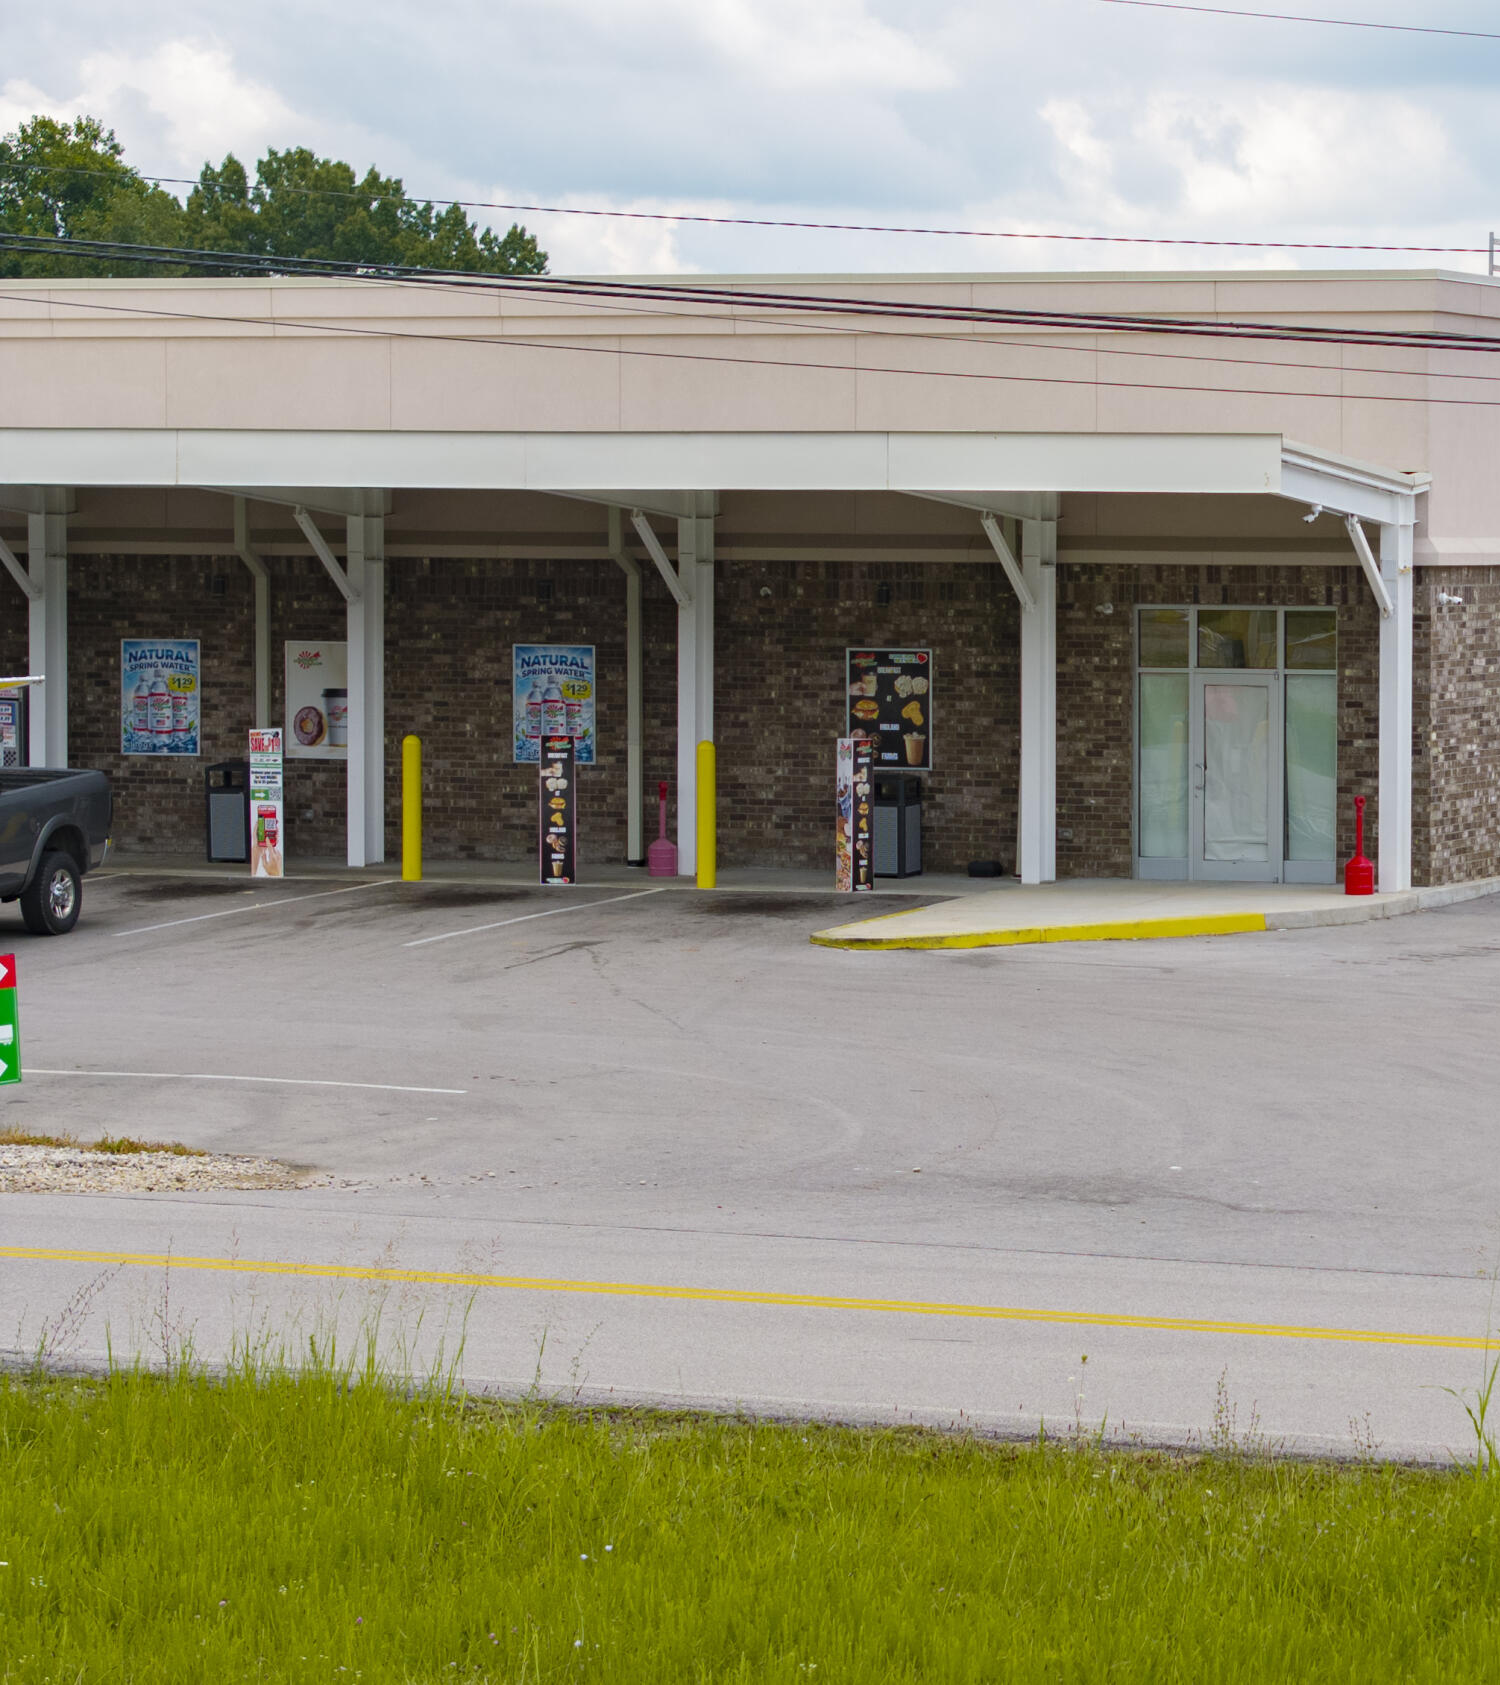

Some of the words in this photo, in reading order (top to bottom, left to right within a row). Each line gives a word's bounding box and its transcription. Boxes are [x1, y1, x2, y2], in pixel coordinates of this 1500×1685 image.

[128, 648, 193, 663] NATURAL
[521, 655, 589, 669] NATURAL
[129, 661, 159, 672] SPRING
[160, 661, 190, 671] WATER
[522, 667, 552, 678] SPRING
[554, 667, 584, 677] WATER
[250, 737, 264, 752] SAVE
